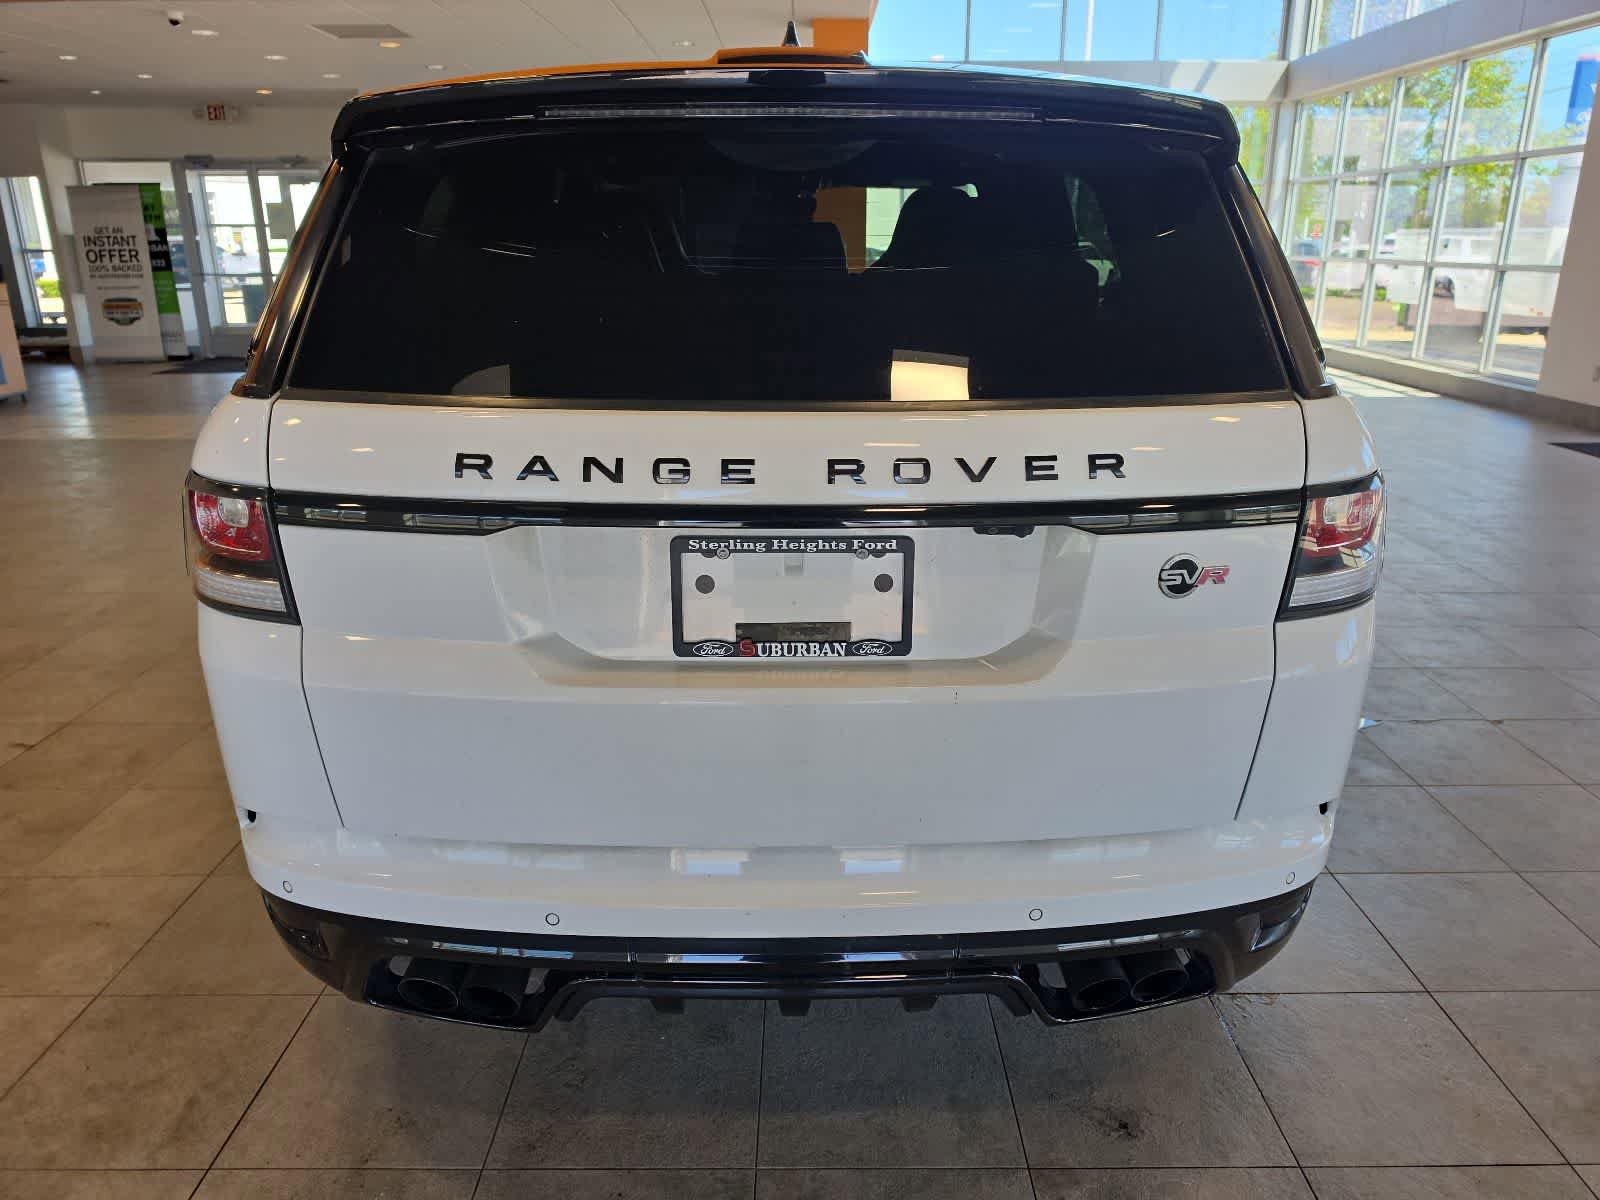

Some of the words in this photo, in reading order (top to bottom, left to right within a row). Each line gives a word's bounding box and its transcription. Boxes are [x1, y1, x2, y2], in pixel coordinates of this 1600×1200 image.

[207, 104, 226, 121] EXIT
[94, 226, 109, 234] GET
[112, 226, 123, 234] AN
[83, 235, 136, 248] INSTANT
[85, 248, 140, 264] OFFER
[88, 264, 110, 273] 100%
[112, 263, 143, 273] BACKED
[454, 452, 756, 485] RANGE
[827, 453, 1127, 485] ROVER
[688, 539, 767, 553] Sterling
[771, 539, 848, 553] Heights
[852, 539, 898, 551] Ford
[1159, 561, 1231, 587] SVR
[700, 642, 727, 655] Ford
[740, 639, 848, 657] SUBURBAN
[859, 642, 886, 655] Ford
